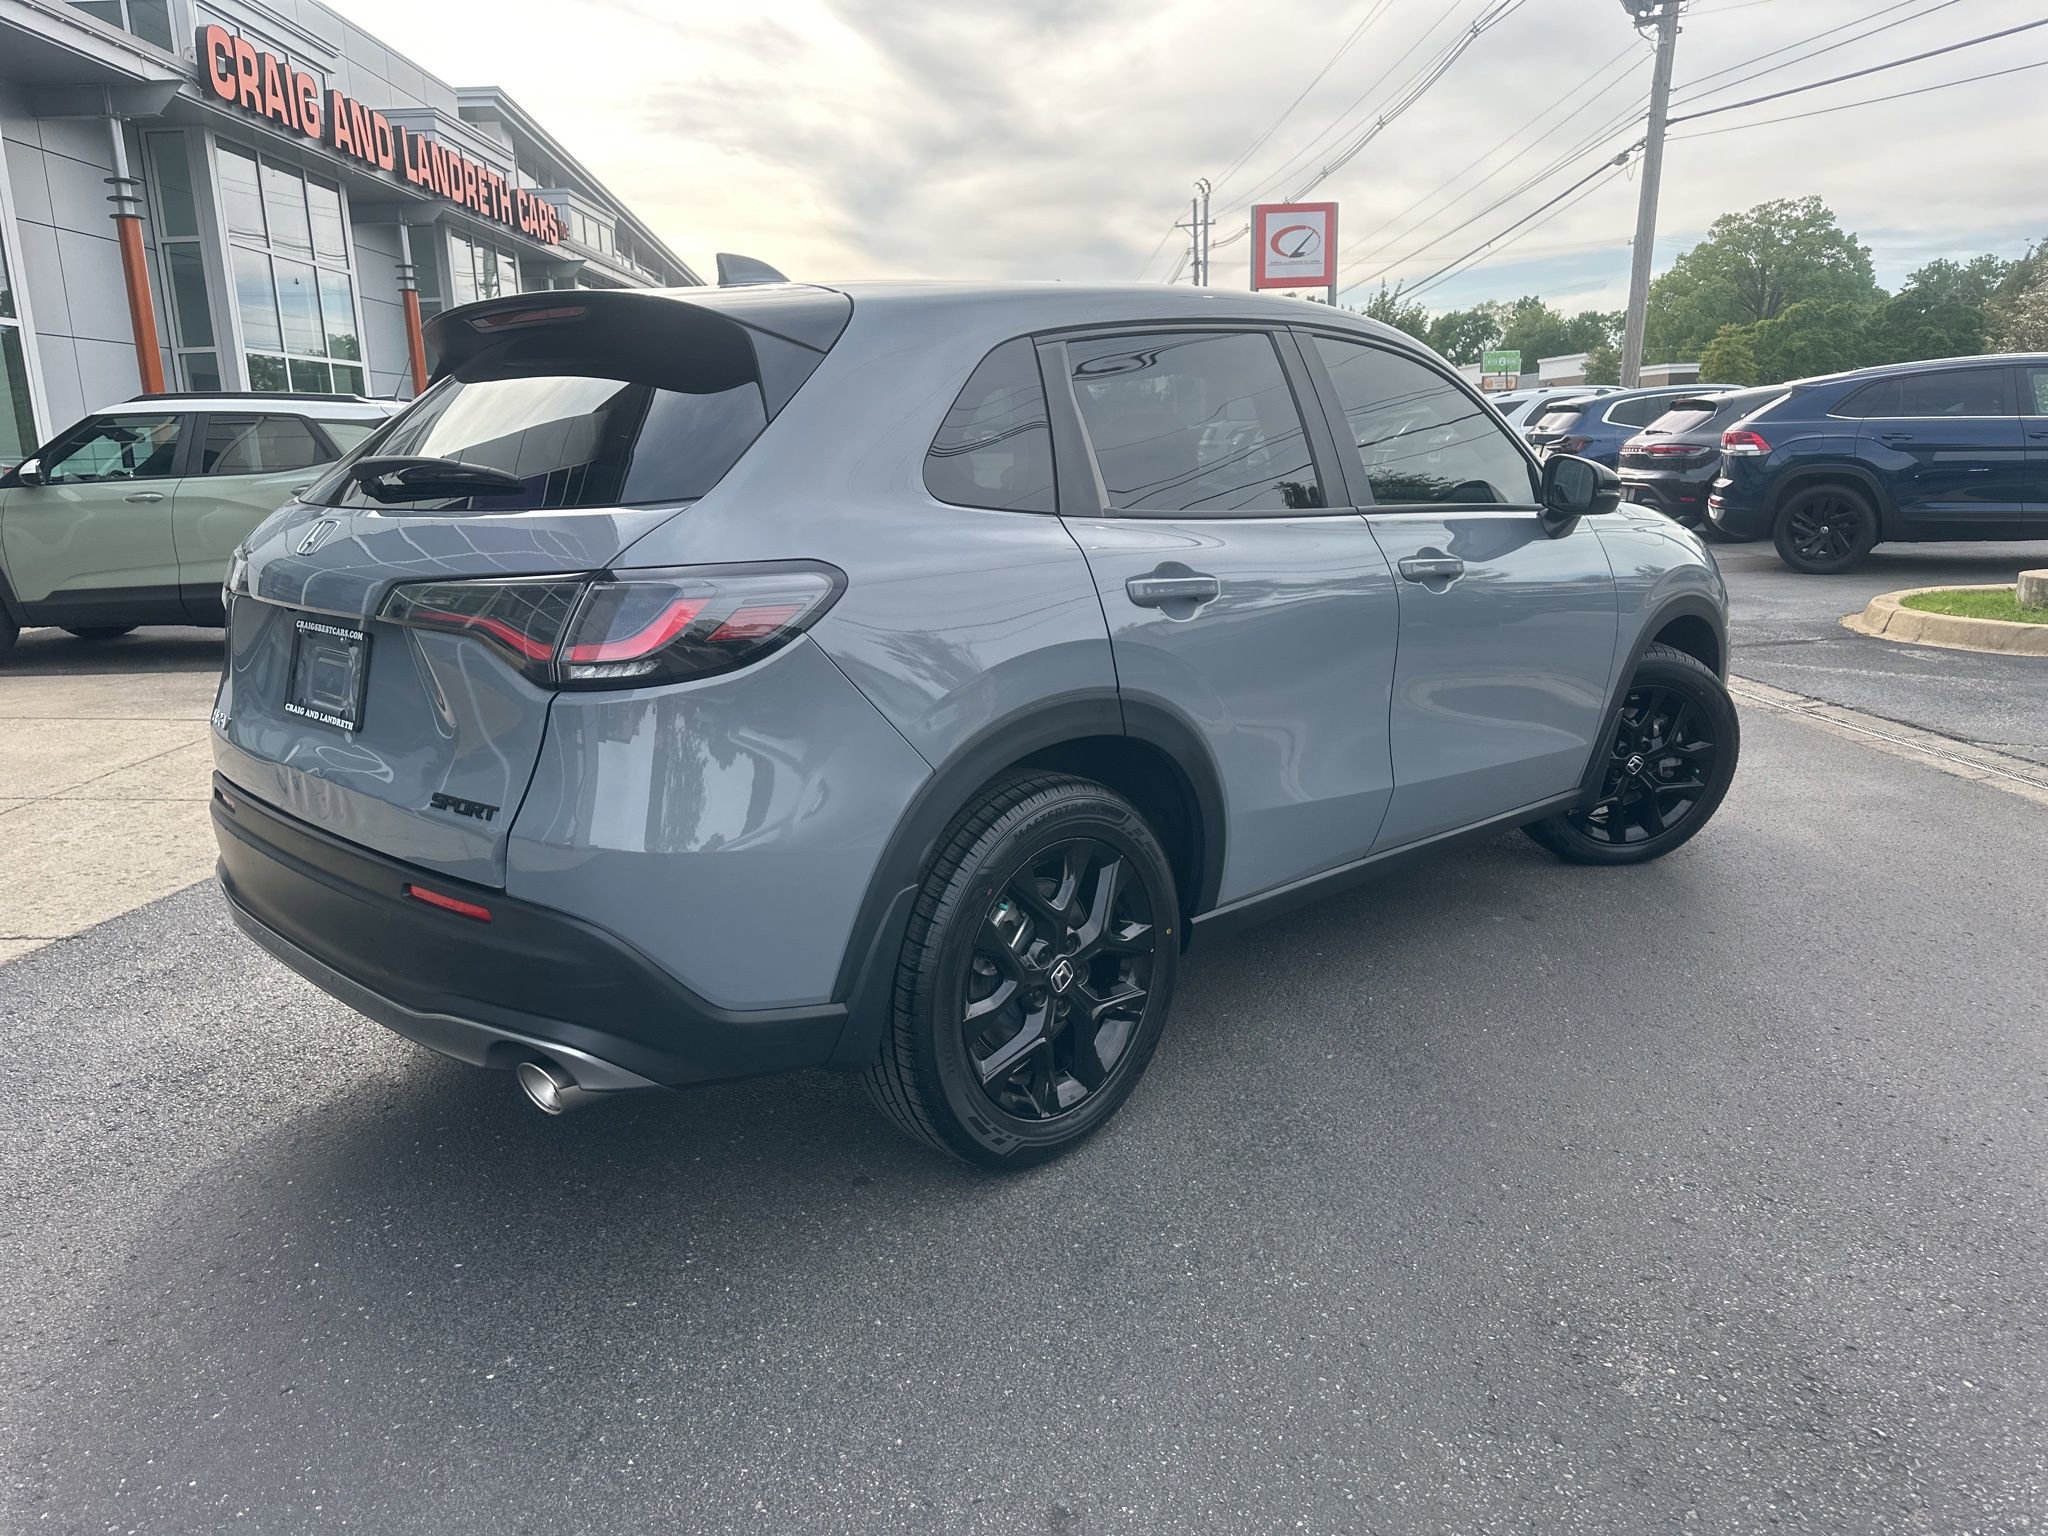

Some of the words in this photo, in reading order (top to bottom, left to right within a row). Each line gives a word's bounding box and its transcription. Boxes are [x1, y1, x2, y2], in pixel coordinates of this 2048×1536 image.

[206, 24, 321, 139] CRAIG
[333, 89, 395, 171] AND
[401, 126, 513, 226] LANDRETH
[517, 188, 560, 245] CARS
[296, 620, 363, 640] CRAIGSBESTCARS.COM
[285, 703, 304, 715] CRAIG
[305, 709, 319, 720] AND
[319, 713, 353, 730] LANDRETH
[430, 792, 500, 821] SPORT
